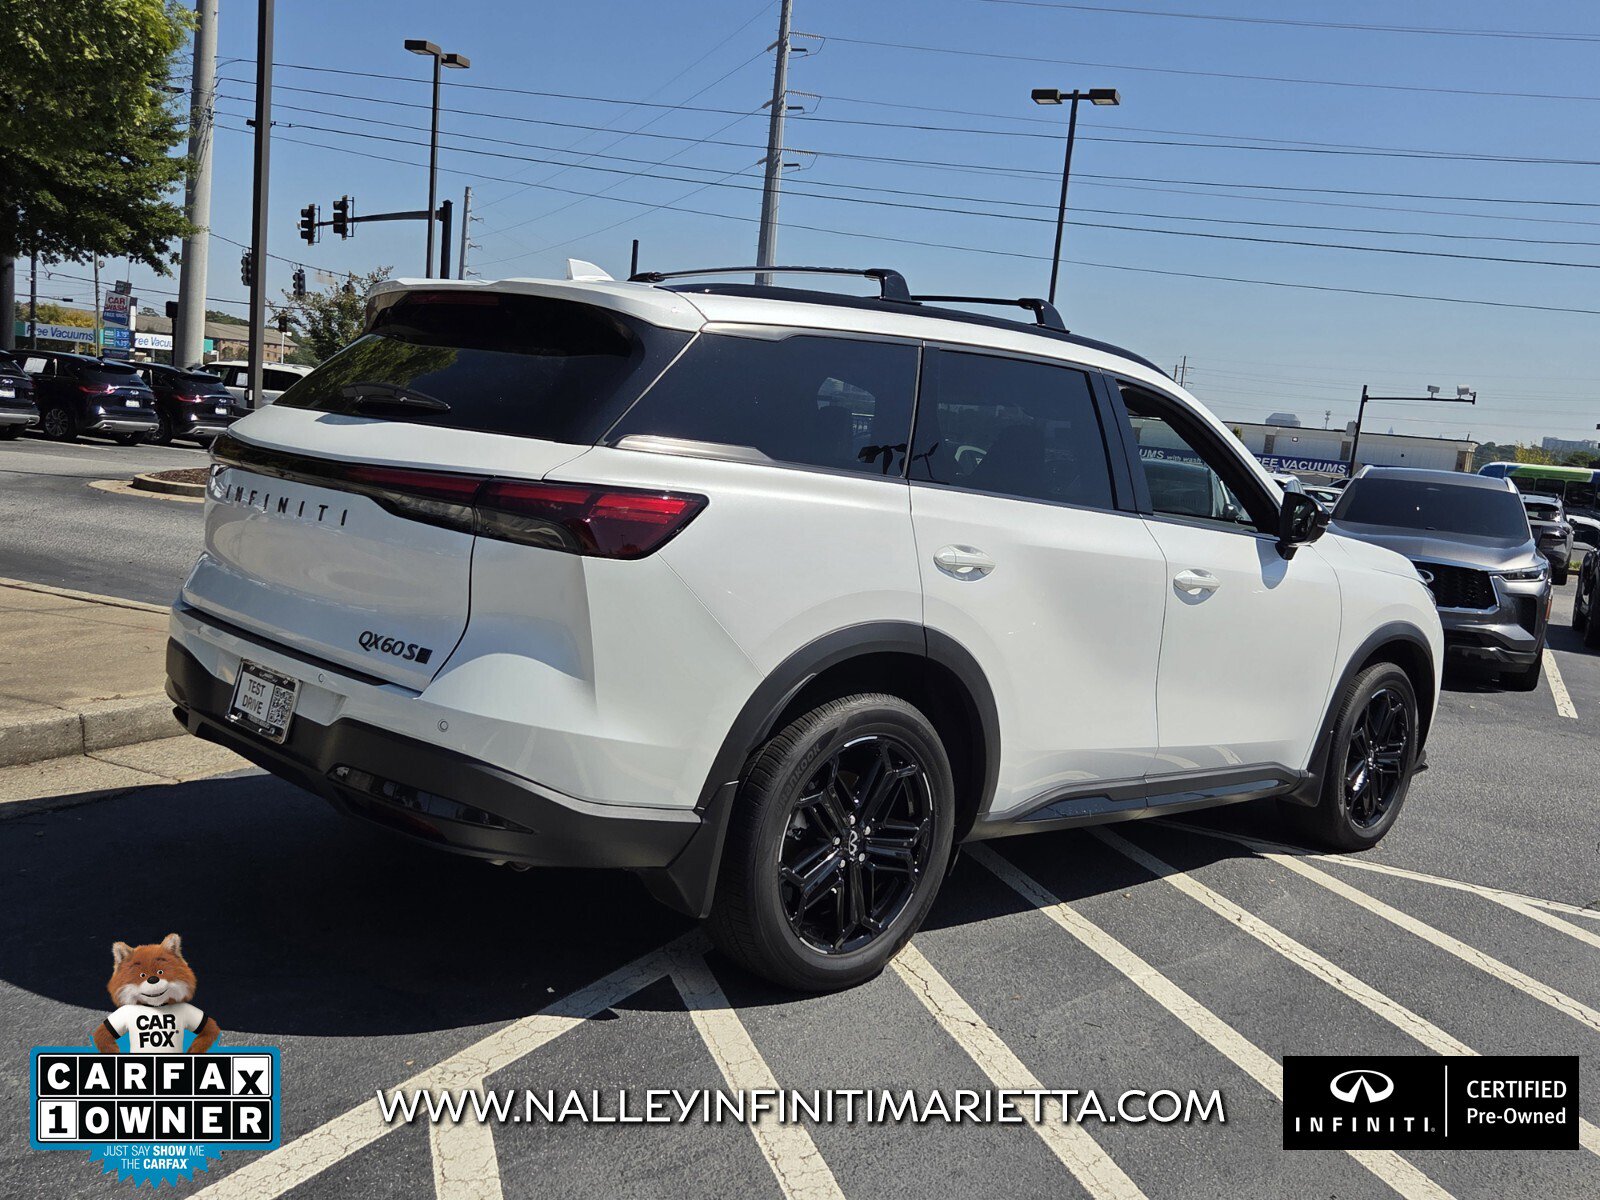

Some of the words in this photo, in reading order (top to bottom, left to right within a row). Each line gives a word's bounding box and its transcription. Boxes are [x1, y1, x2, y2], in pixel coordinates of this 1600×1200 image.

[107, 296, 126, 305] CAR
[26, 324, 48, 336] Fee
[50, 326, 93, 341] Vacuums
[1281, 459, 1347, 474] VACUUMS
[225, 484, 348, 526] INFINITI
[248, 679, 266, 697] TEST
[242, 694, 264, 715] DRIVE
